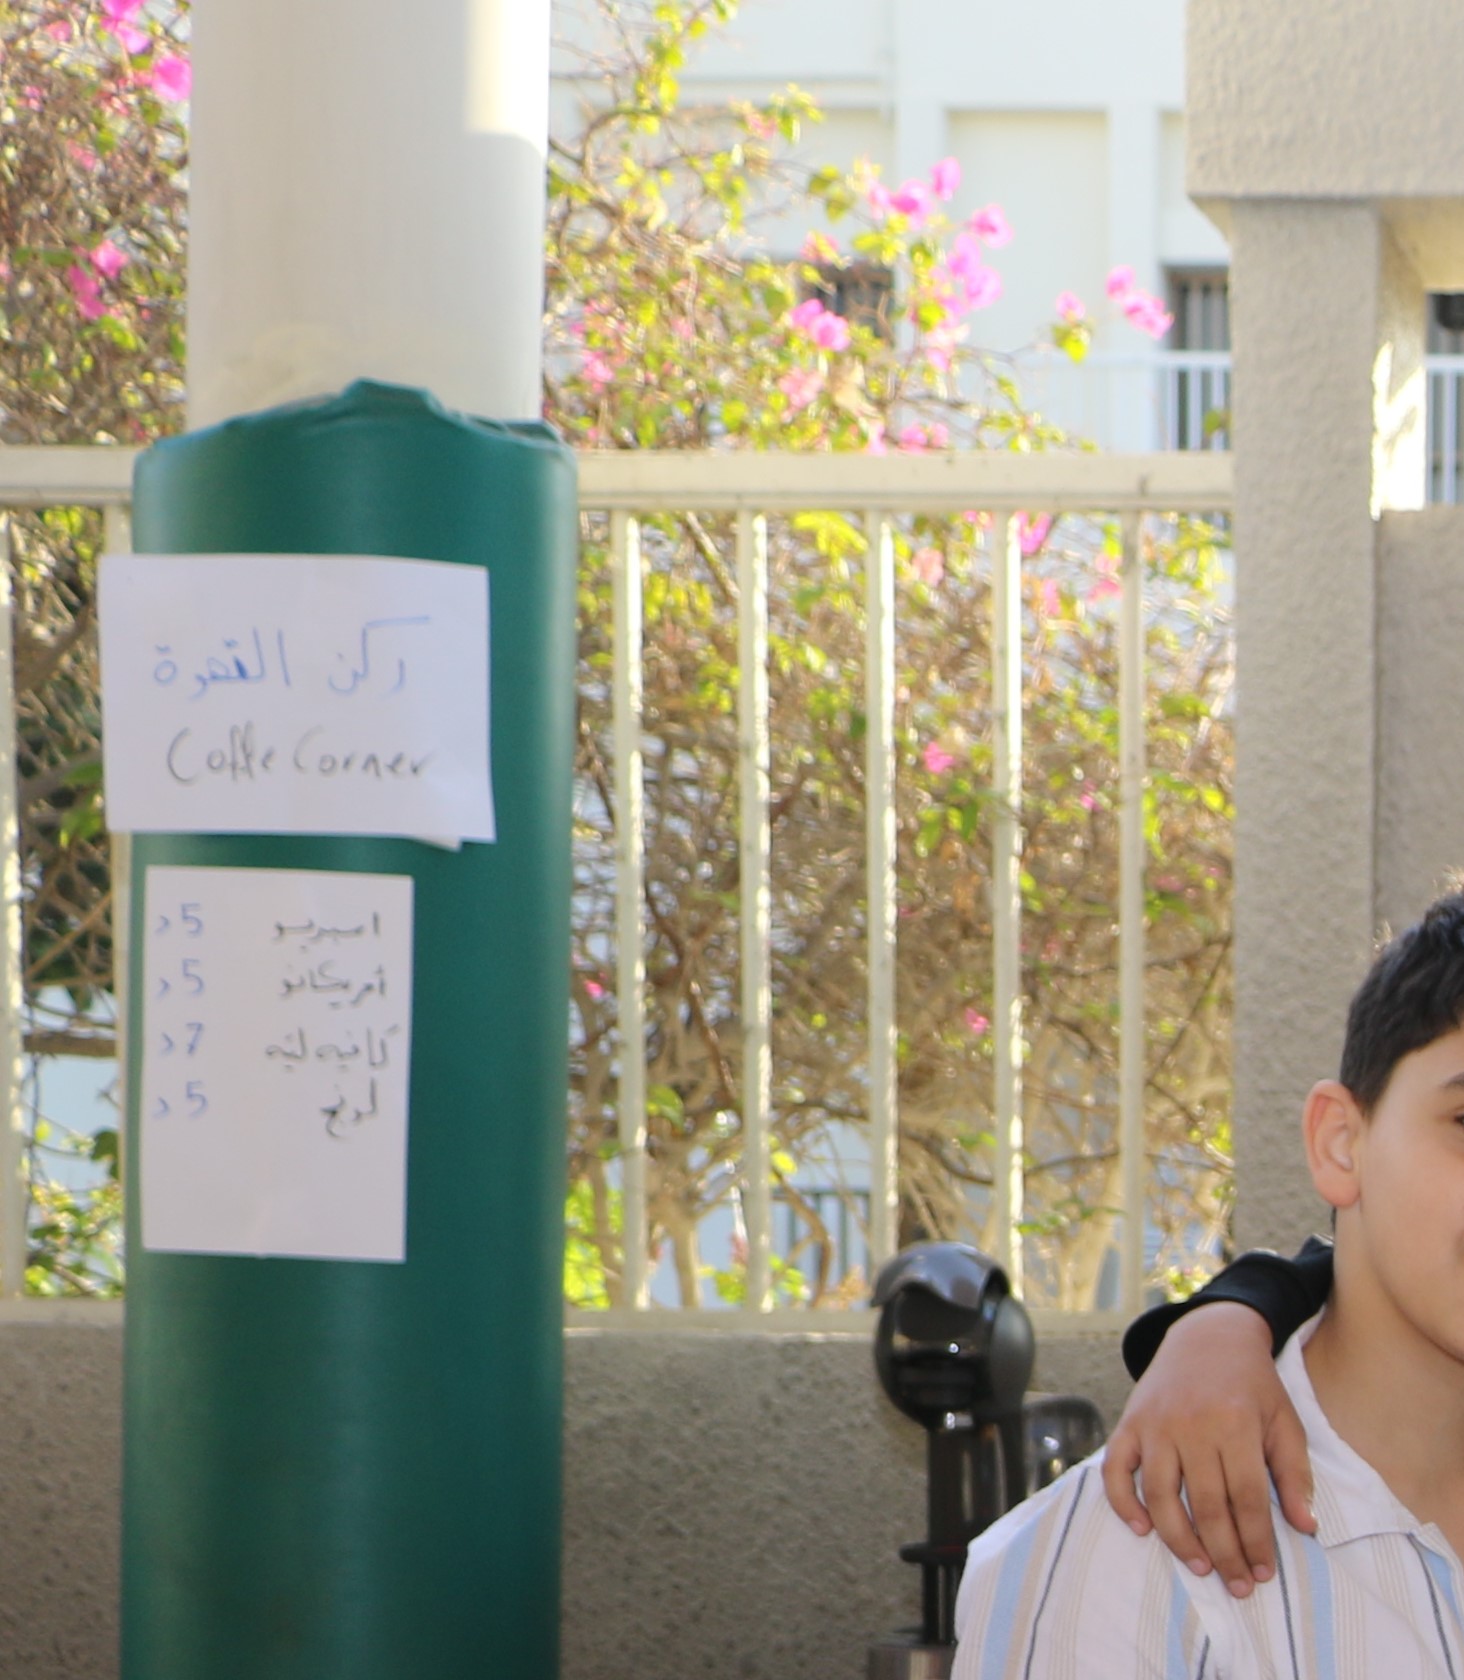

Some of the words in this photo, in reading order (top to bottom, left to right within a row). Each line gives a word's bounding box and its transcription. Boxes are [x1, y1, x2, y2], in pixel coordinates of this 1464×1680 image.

[151, 627, 293, 699] القهوة
[326, 613, 432, 697] ركن
[167, 721, 277, 787] Coffe
[293, 726, 433, 780] Corner
